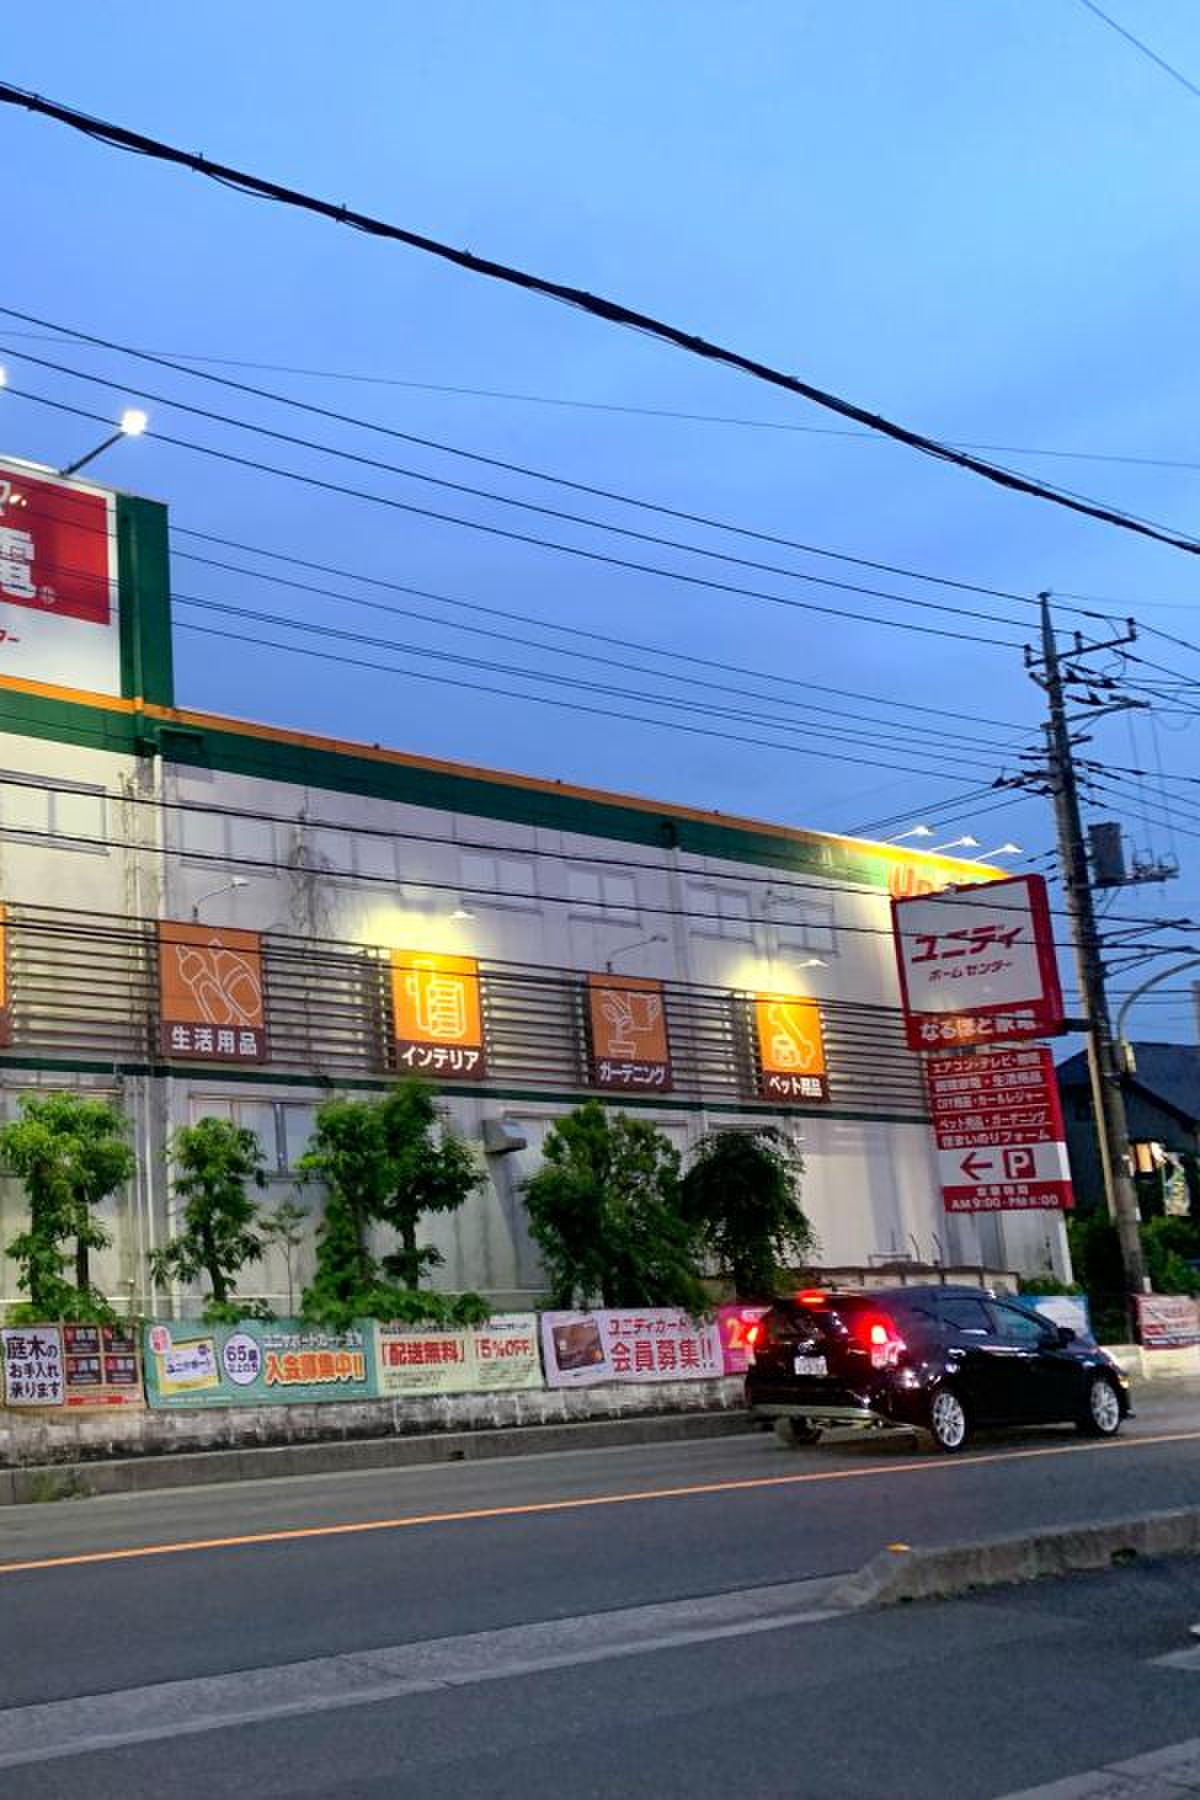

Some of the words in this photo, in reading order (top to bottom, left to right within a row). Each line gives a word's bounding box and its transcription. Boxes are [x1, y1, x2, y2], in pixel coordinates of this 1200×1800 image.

[911, 925, 1024, 963] ユニディ
[171, 1026, 257, 1056] 生活用品
[401, 1045, 479, 1072] インテリア
[599, 1062, 666, 1086] ガーデニング
[769, 1075, 823, 1097] ペット用品
[1009, 1151, 1030, 1178] P
[6, 1336, 58, 1360] 庭木の
[9, 1364, 60, 1379] お手入れ
